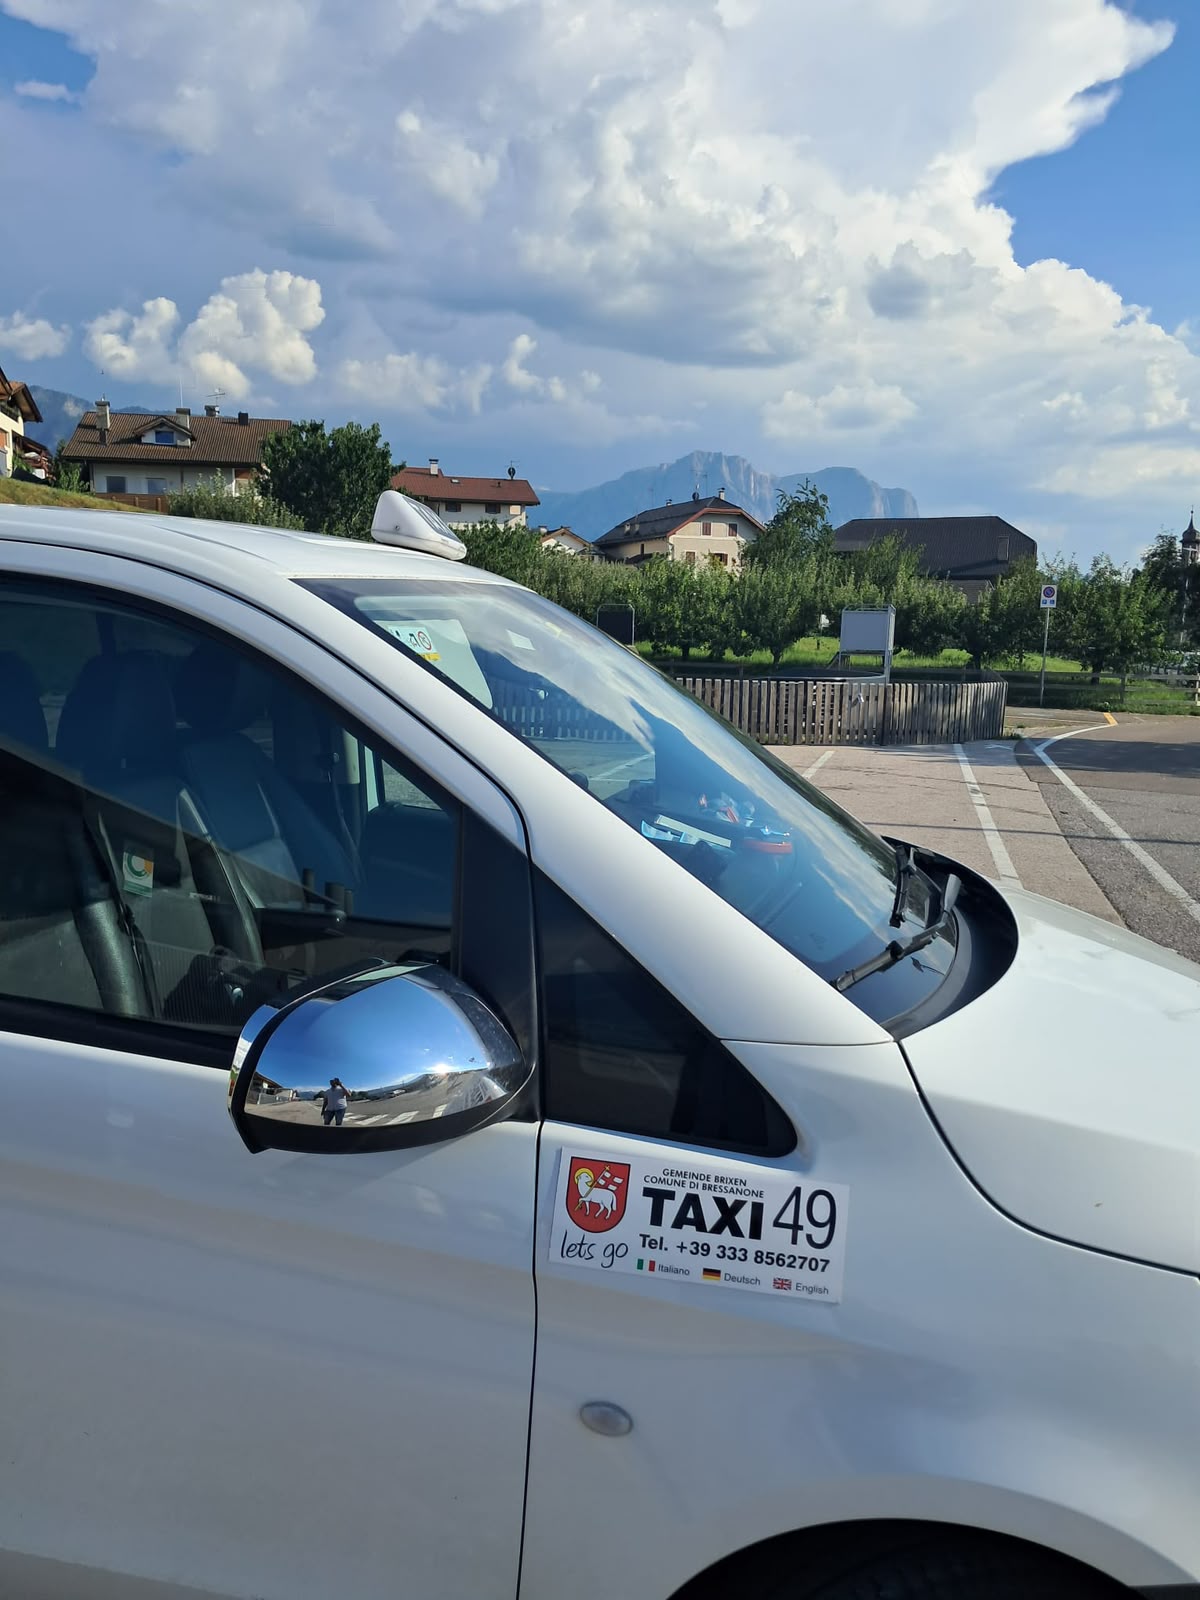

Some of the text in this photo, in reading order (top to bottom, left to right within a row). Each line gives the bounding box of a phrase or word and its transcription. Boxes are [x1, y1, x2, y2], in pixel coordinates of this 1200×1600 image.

[643, 1175, 764, 1198] COMUNE DI BRESSANONE
[662, 1168, 747, 1187] GEMEINDE BRIXEN
[642, 1186, 837, 1250] TAXI 49
[560, 1230, 629, 1268] lets go
[639, 1233, 830, 1273] Tel. +39 333 8562707
[658, 1264, 690, 1276] Italiano
[724, 1273, 761, 1286] Deutsch
[795, 1282, 829, 1296] English
